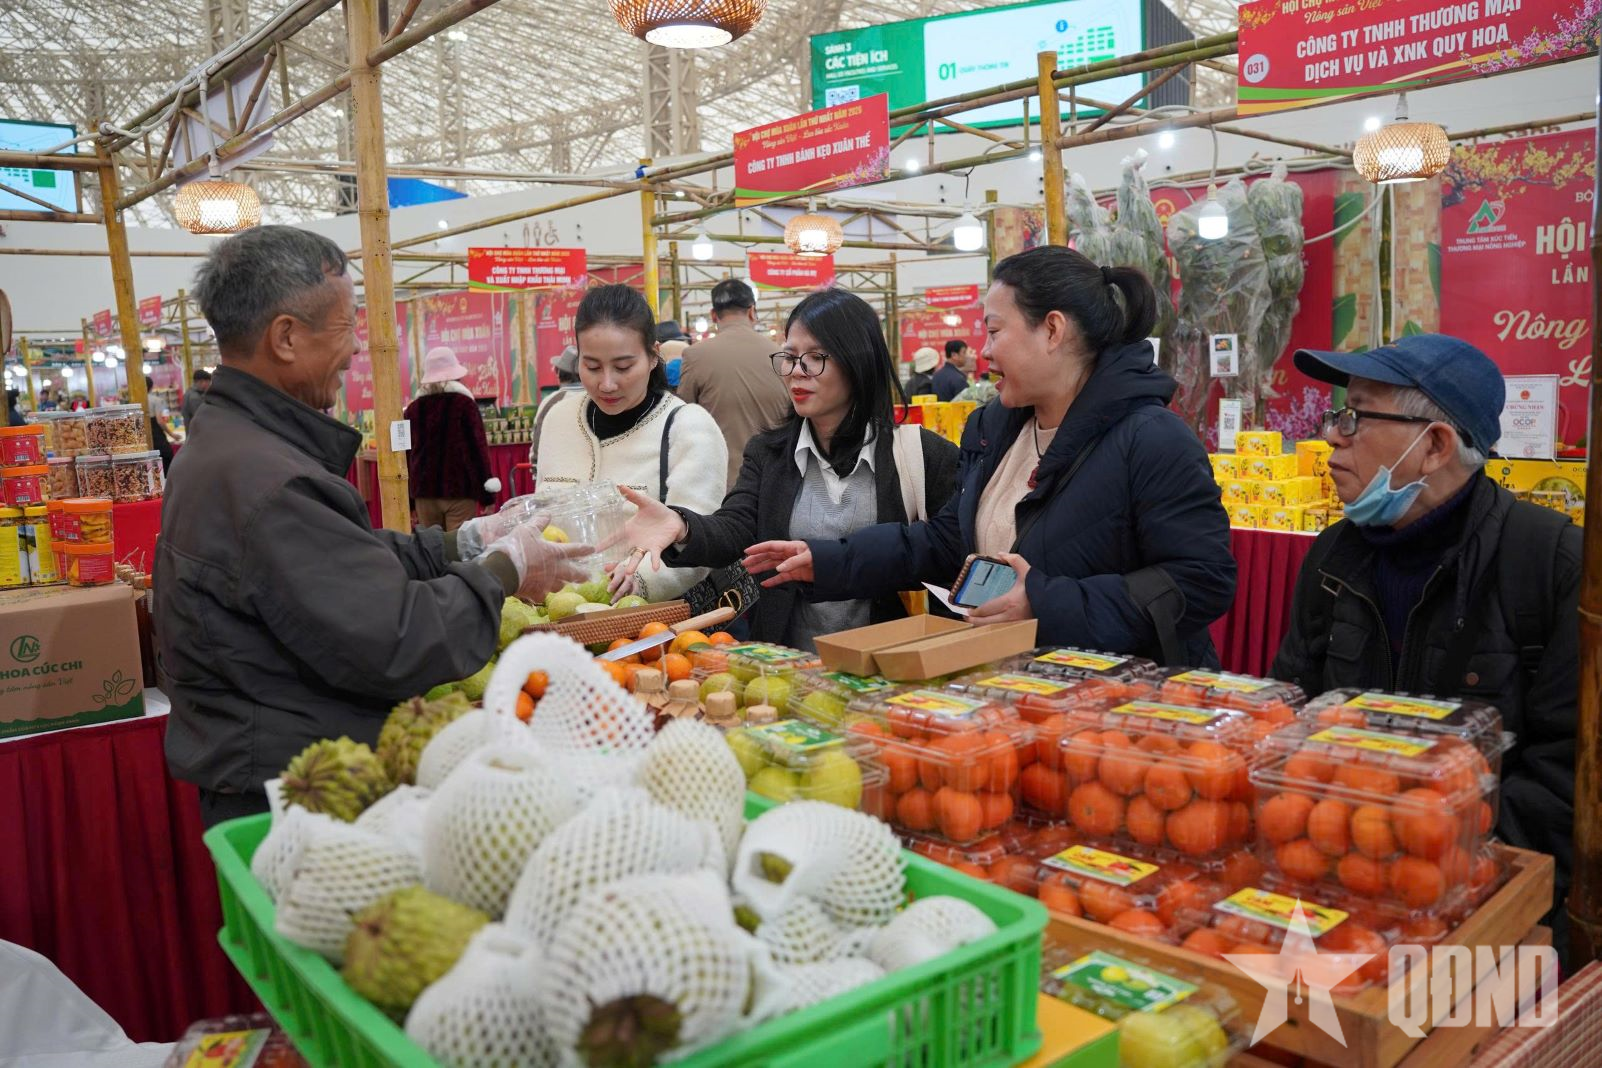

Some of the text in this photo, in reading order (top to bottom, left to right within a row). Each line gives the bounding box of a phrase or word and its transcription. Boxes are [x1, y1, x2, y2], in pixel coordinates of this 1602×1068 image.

[1304, 9, 1335, 24] Nông
[1337, 4, 1355, 16] sản
[1297, 0, 1521, 58] CÔNG TY TNHH THƯƠNG MẠI
[825, 49, 889, 70] CÁC TIỆN ÍCH
[1305, 23, 1509, 83] DỊCH VỤ VÀ XNK QUY HOA
[939, 62, 956, 80] 01
[1248, 61, 1264, 75] 031
[819, 111, 833, 124] NHẤT
[834, 108, 847, 120] NĂM
[747, 130, 871, 174] CÔNG TY TNHH BÁNH KẸO XUÂN THẾ
[1536, 217, 1586, 260] HỘI
[486, 274, 496, 283] VÀ
[492, 265, 507, 274] CÔNG
[508, 266, 515, 274] TY
[516, 266, 531, 274] TNHH
[532, 265, 554, 274] THƯƠNG
[1552, 261, 1589, 285] LẦN
[1493, 310, 1590, 350] Nông
[33, 662, 59, 676] CÚC
[61, 660, 82, 671] CHI
